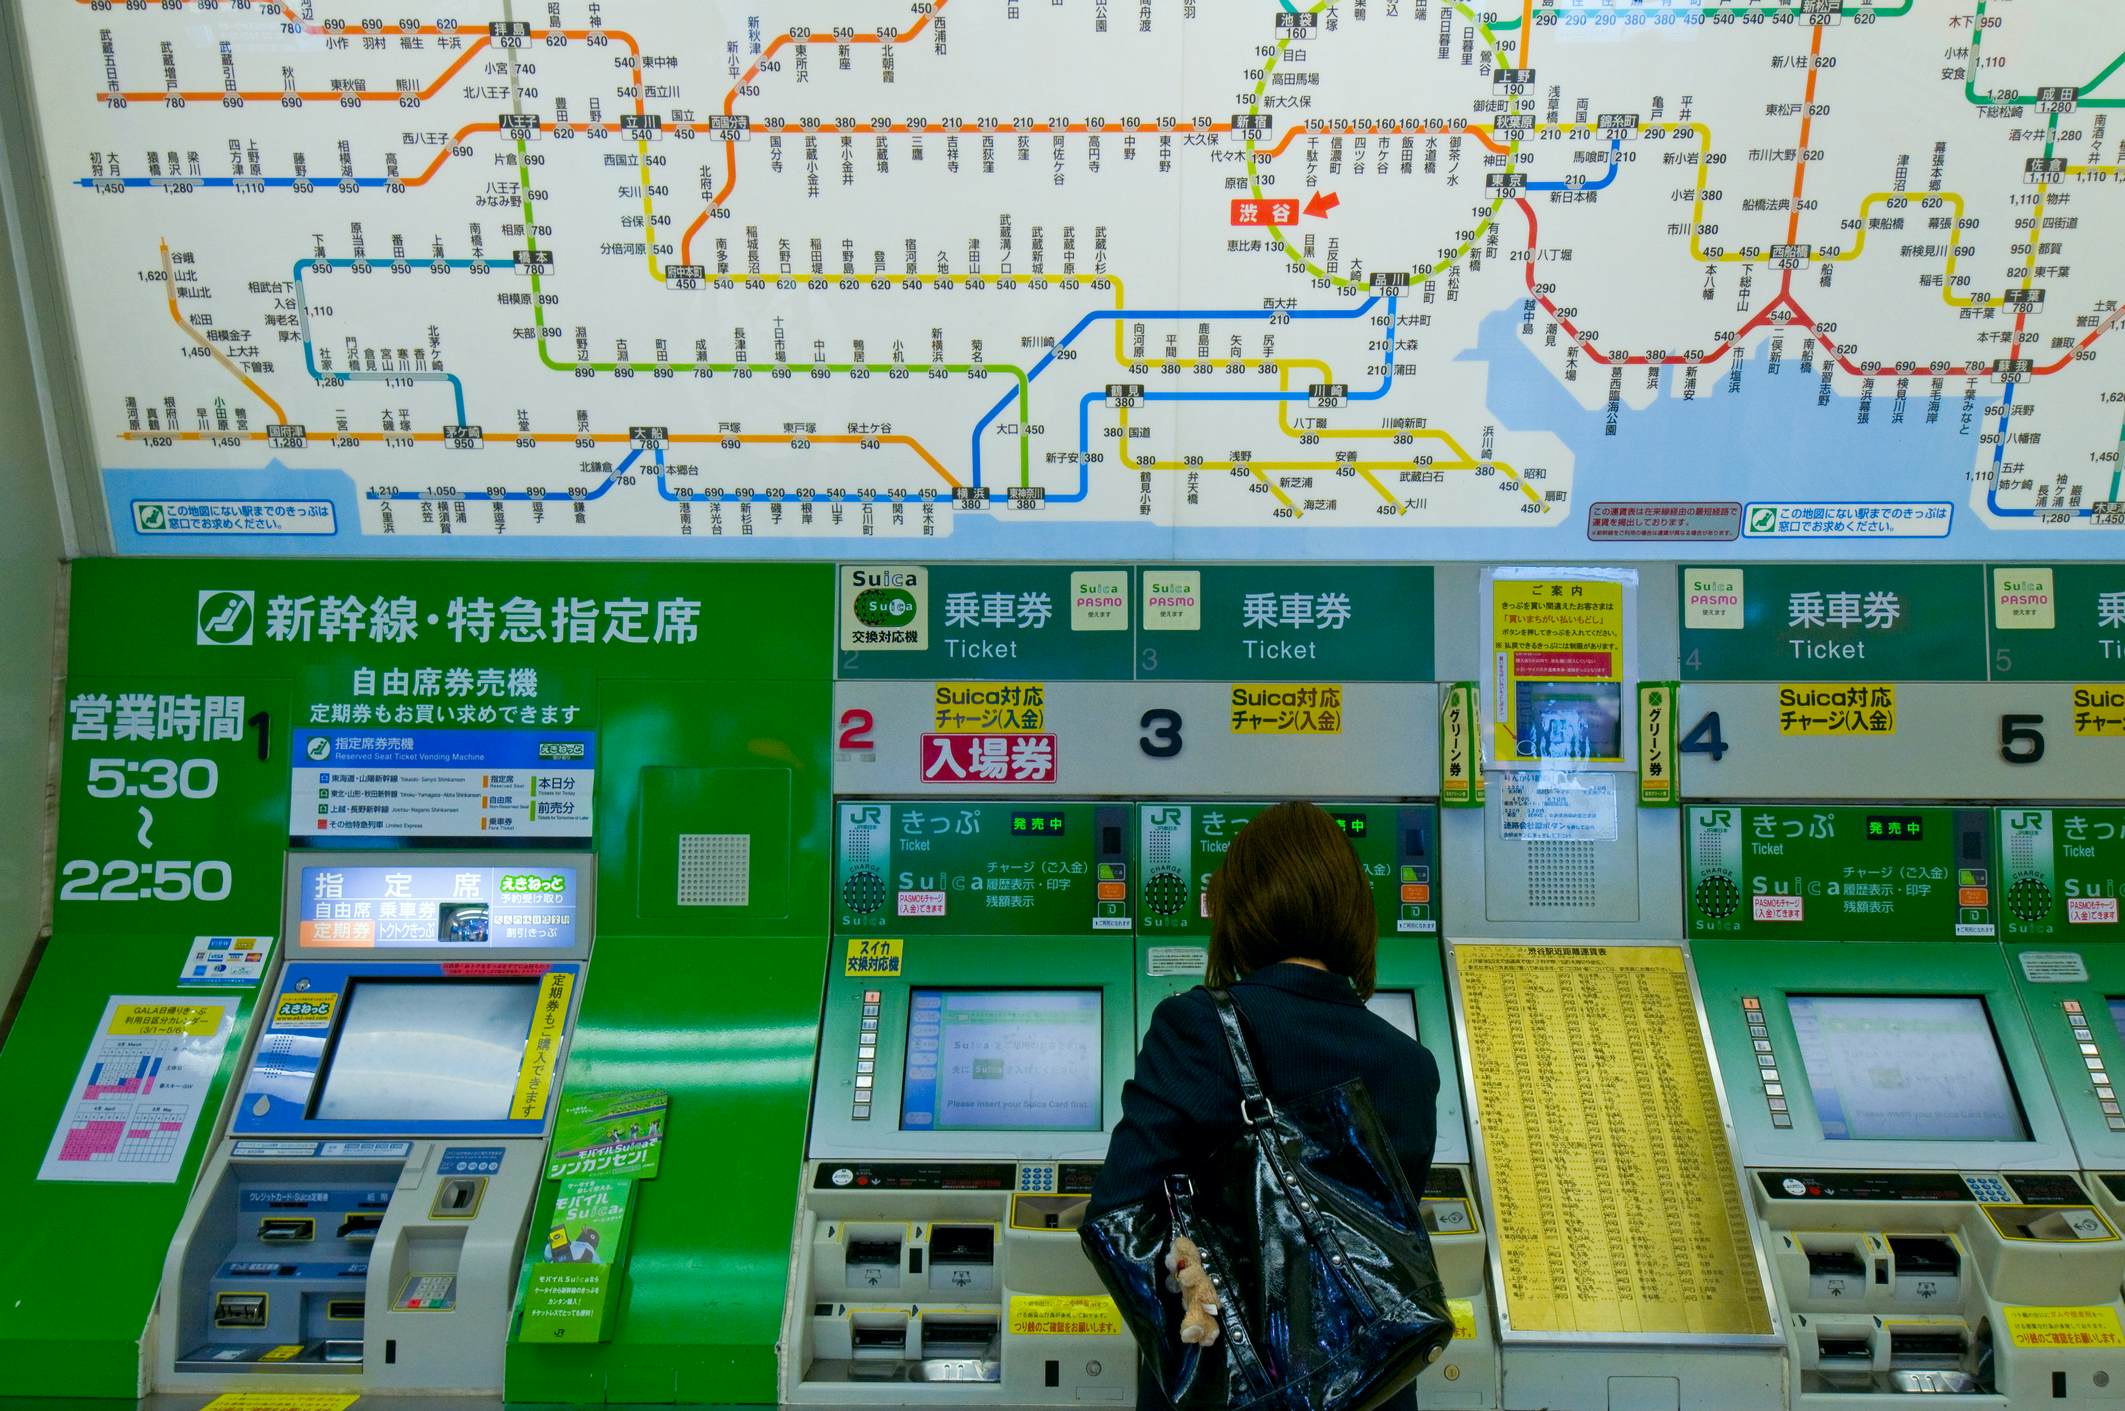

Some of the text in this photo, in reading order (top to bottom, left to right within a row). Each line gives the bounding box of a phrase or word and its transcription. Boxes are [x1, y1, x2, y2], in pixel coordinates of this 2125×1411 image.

[324, 19, 345, 31] 690
[1280, 13, 1313, 27] 池袋
[494, 23, 525, 36] 拝島
[1286, 28, 1307, 39] 160
[325, 37, 349, 50] 小作
[500, 37, 522, 48] 620
[99, 29, 120, 92] 武蔵五日市
[642, 56, 678, 68] 東中神
[1771, 55, 1808, 69] 新八柱
[1272, 73, 1320, 86] 高田馬場
[1498, 69, 1530, 83] 上野
[331, 79, 366, 92] 東秋留
[396, 79, 420, 92] 熊川
[463, 87, 511, 99] 北八王子
[2041, 88, 2074, 101] 成田
[1264, 95, 1312, 109] 新大久保
[671, 109, 695, 121] 国立
[1975, 105, 2024, 120] 下総松崎
[502, 115, 537, 128] 八王子
[626, 115, 657, 128] 立川
[711, 116, 749, 129] 西国分寺
[1236, 115, 1268, 129] 新宿
[1496, 115, 1535, 129] 秋葉原
[1600, 115, 1636, 128] 錦糸町
[402, 133, 449, 145] 西八王子
[510, 129, 532, 140] 690
[631, 129, 653, 140] 540
[1183, 134, 1219, 146] 大久保
[946, 135, 959, 173] 吉祥寺
[1211, 150, 1246, 163] 代々木
[1748, 149, 1797, 162] 市川大野
[293, 152, 307, 177] 藤野
[1225, 177, 1248, 190] 原宿
[1491, 174, 1522, 187] 東京
[95, 183, 125, 194] 1,450
[1550, 191, 1597, 204] 新日本橋
[1238, 203, 1292, 223] 渋谷
[1868, 217, 1904, 231] 東船橋
[2042, 217, 2078, 230] 四街道
[518, 252, 549, 264] 橋本
[1537, 249, 1572, 261] 八丁堀
[1770, 245, 1809, 259] 西船橋
[1374, 273, 1405, 286] 品川
[2009, 290, 2041, 302] 千葉
[1263, 298, 1297, 310] 西大井
[2012, 302, 2034, 313] 780
[264, 314, 299, 326] 海老名
[1397, 314, 1431, 327] 大井町
[1021, 336, 1055, 348] 新川崎
[1111, 385, 1140, 397] 鶴見
[1312, 385, 1344, 397] 川崎
[783, 422, 817, 434] 東戸塚
[1381, 417, 1427, 430] 川崎新町
[634, 428, 663, 440] 大船
[143, 437, 173, 447] 1,620
[666, 464, 699, 477] 本郷台
[956, 488, 985, 500] 横浜
[167, 505, 329, 518] この地図にない駅までのきっぷは
[1780, 508, 1947, 520] この地図にない駅までのきっぷは
[169, 518, 282, 530] 窓口でお求めください。
[1779, 520, 1895, 533] 窓口でお求めください。
[852, 569, 918, 587] Suica
[1080, 582, 1118, 596] Suica
[1151, 582, 1191, 595] Suica
[1532, 585, 1583, 596] ご案内
[1694, 579, 1735, 592] Suica
[2003, 579, 2043, 592] Suica
[1076, 596, 1122, 608] PASMO
[1149, 596, 1194, 608] PASMO
[1501, 602, 1614, 611] きっぷを買い間違えたお客さまは
[1690, 594, 1738, 606] PASMO
[2000, 594, 2048, 606] PASMO
[944, 592, 1053, 629] 乗車券
[1242, 592, 1352, 629] 乗車券
[1787, 592, 1900, 629] 乗車券
[265, 596, 702, 645] 新幹線・特急指定席
[1503, 615, 1604, 624] 「買いまちがい払いもどし」
[851, 630, 918, 644] 交換対応機
[944, 639, 1018, 659] Ticket
[1242, 640, 1316, 659] Ticket
[1789, 640, 1865, 660] Ticket
[352, 667, 539, 698] 自由席券売機
[936, 686, 1044, 707] Suica対応
[1232, 687, 1341, 709] Suica対応
[1780, 687, 1892, 709] Suica対応
[69, 695, 245, 742] 営業時間
[308, 703, 581, 726] 定期券もお買い求めできます
[935, 709, 1045, 731] チャージ(入金)
[1232, 710, 1342, 732] チャージ(入金)
[1780, 710, 1894, 733] チャージ(入金)
[250, 712, 270, 760] 1
[838, 709, 875, 750] 2
[1139, 708, 1183, 758] 3
[1450, 709, 1461, 777] グリーン券
[1649, 709, 1662, 776] グリーン券
[1678, 711, 1729, 762] 4
[2001, 714, 2046, 764] 5
[335, 737, 414, 751] 指定席券売機
[336, 752, 485, 762] Reserved Seat Ticket Vending Machine
[925, 737, 1053, 781] 入場券
[87, 759, 218, 800] 5:30
[490, 776, 514, 784] 指定席
[538, 777, 575, 789] 本日分
[490, 796, 512, 804] 自由席
[538, 802, 575, 814] 前売分
[489, 818, 512, 826] 乗車券
[850, 807, 881, 824] JR
[1151, 808, 1182, 825] JR
[1700, 810, 1731, 829] JR
[2011, 812, 2043, 830] JR
[329, 820, 383, 828] その他特急列車
[901, 810, 980, 836] きっぷ
[1013, 817, 1063, 830] 発売中
[1752, 813, 1835, 838] きっぷ
[1869, 821, 1921, 835] 発売中
[900, 839, 930, 851] Ticket
[1752, 843, 1784, 856] Ticket
[2064, 845, 2095, 858] Ticket
[60, 860, 232, 902] 22:50
[501, 876, 563, 891] えきねっと
[900, 872, 983, 890] Suica
[986, 879, 1071, 891] 履歴表示・印字
[1752, 876, 1840, 895] Suica
[1843, 884, 1932, 896] 履歴表示・印字
[986, 896, 1034, 908] 残額表示
[1843, 901, 1894, 913] 残額表示
[316, 902, 370, 919] 自由席
[379, 902, 435, 919] 乗車券
[313, 922, 371, 939] 定期券
[860, 941, 890, 955] スイカ
[848, 956, 899, 972] 交換対応機
[280, 1003, 330, 1015] えきねっと
[557, 1192, 609, 1210] モバイル
